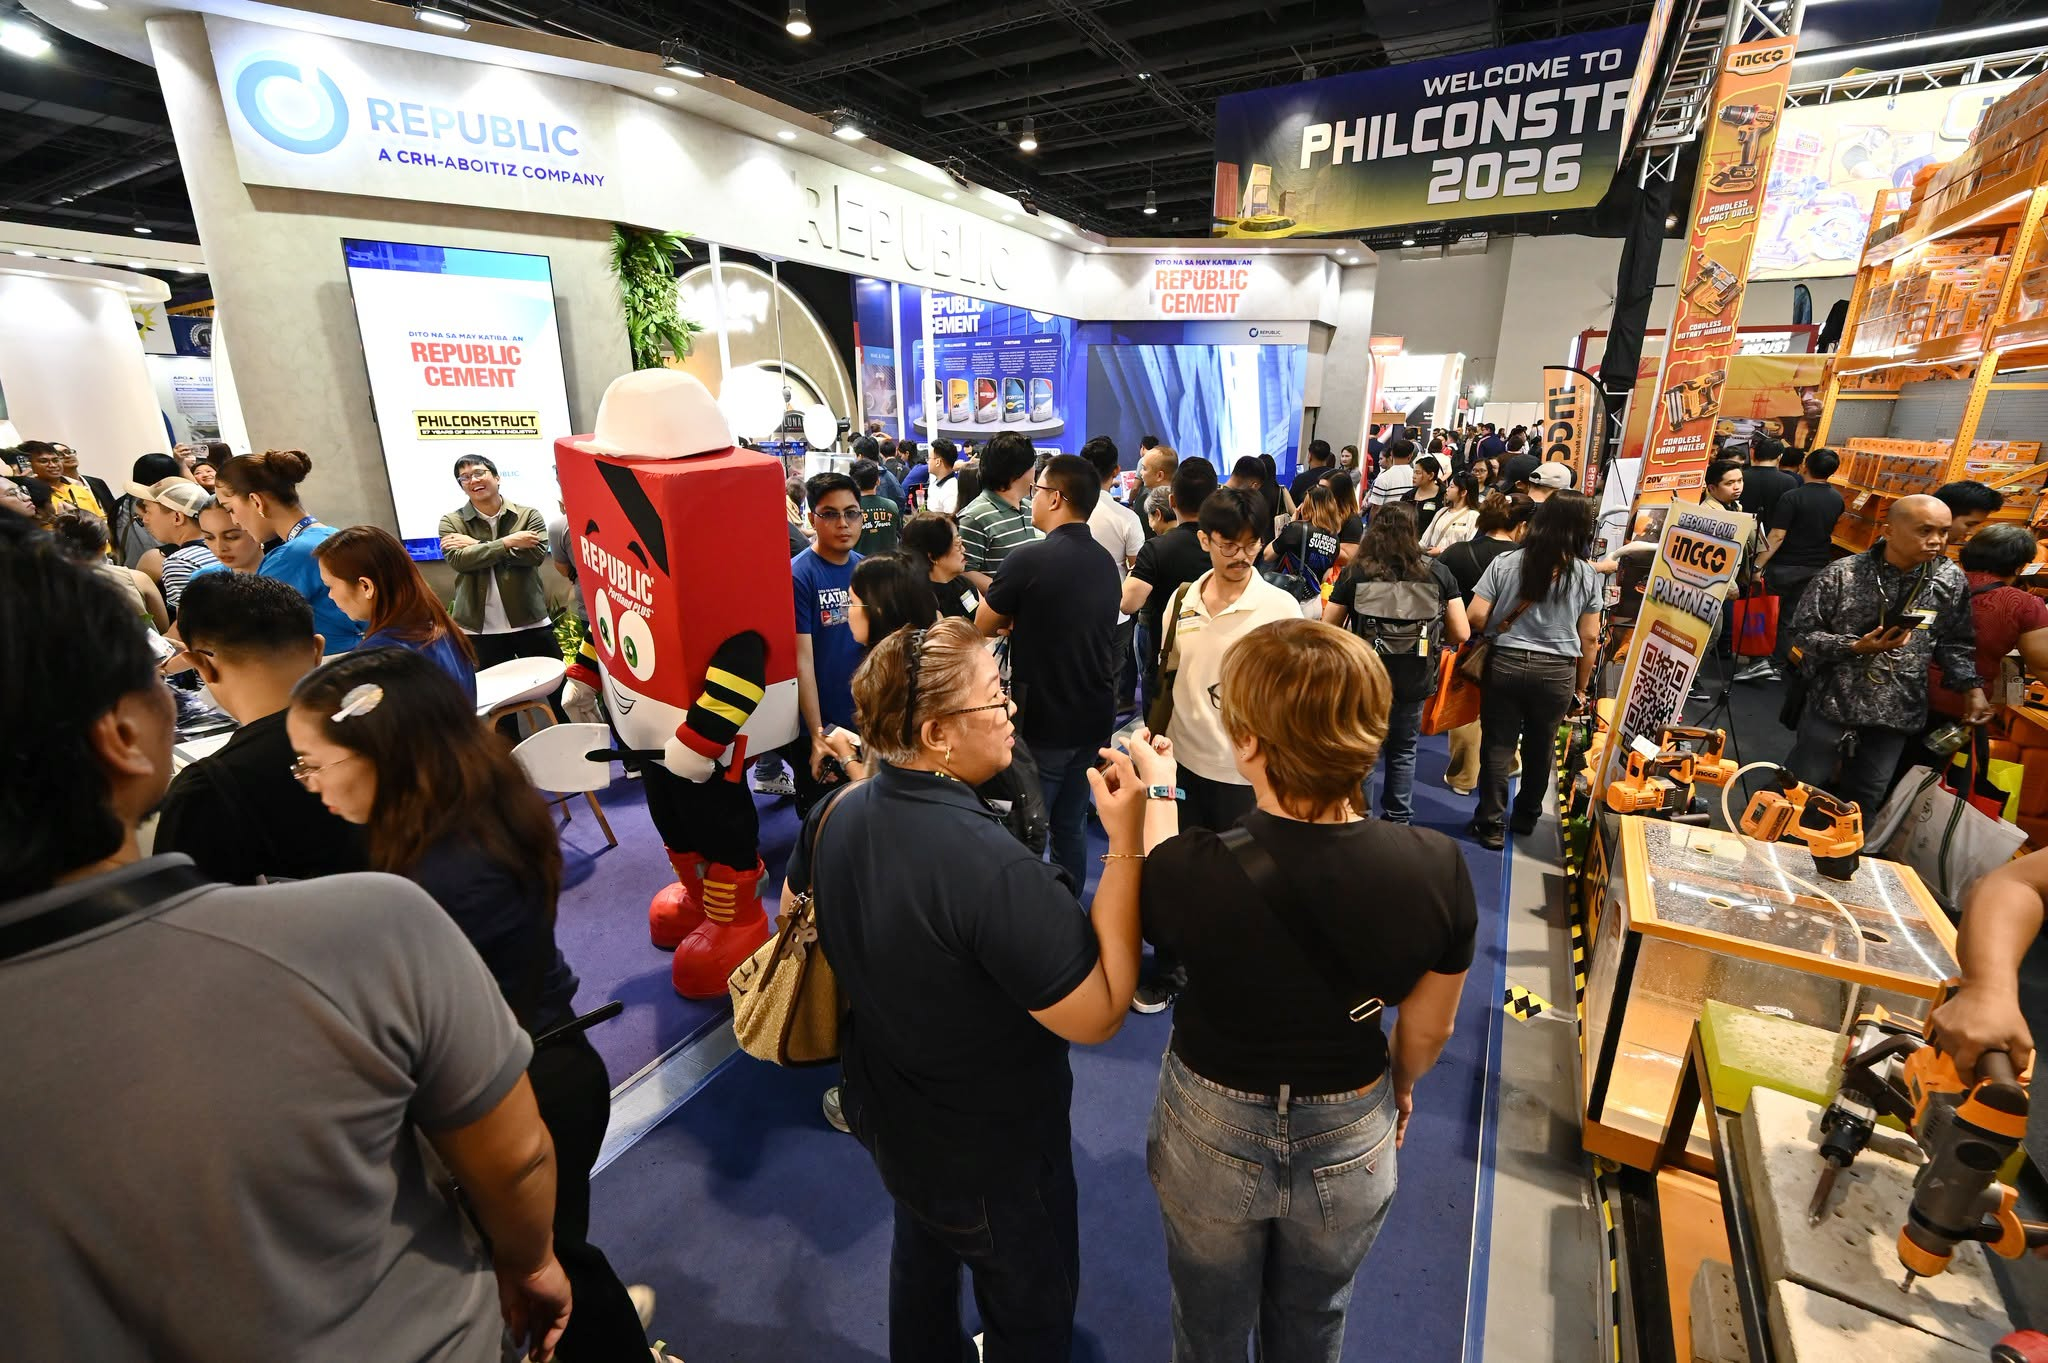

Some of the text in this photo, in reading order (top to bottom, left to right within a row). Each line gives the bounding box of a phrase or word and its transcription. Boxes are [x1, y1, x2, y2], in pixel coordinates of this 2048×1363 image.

[1423, 48, 1623, 97] WELCOME TO
[366, 97, 579, 157] REPUBLIC
[1300, 78, 1634, 170] PHILCONSTR
[378, 148, 605, 187] A CRH-ABOITIZ COMPANY
[1427, 143, 1584, 205] 2026
[1699, 205, 1755, 225] IMPACT DRILL
[1709, 199, 1749, 214] CORDLESS
[792, 171, 1011, 291] REPUBLIC
[1155, 269, 1248, 290] REPUBLIC
[932, 295, 986, 315] EPUBLIC
[1161, 293, 1240, 314] CEMENT
[932, 314, 981, 334] EMENT
[1677, 329, 1703, 340] ROTARY
[1689, 320, 1722, 332] CORDLESS
[478, 334, 524, 342] KATIBAAN
[410, 342, 522, 366] REPUBLIC
[424, 366, 516, 388] CEMENT
[417, 415, 536, 427] PHILCONSTRUCT
[1655, 442, 1706, 455] BRAD NAILER
[1663, 435, 1702, 446] CORDLESS
[1678, 512, 1738, 540] BECOME OUR
[1309, 537, 1337, 554] SUCCESS
[580, 535, 654, 606] REPUBLIC
[1652, 576, 1721, 625] PARTNER
